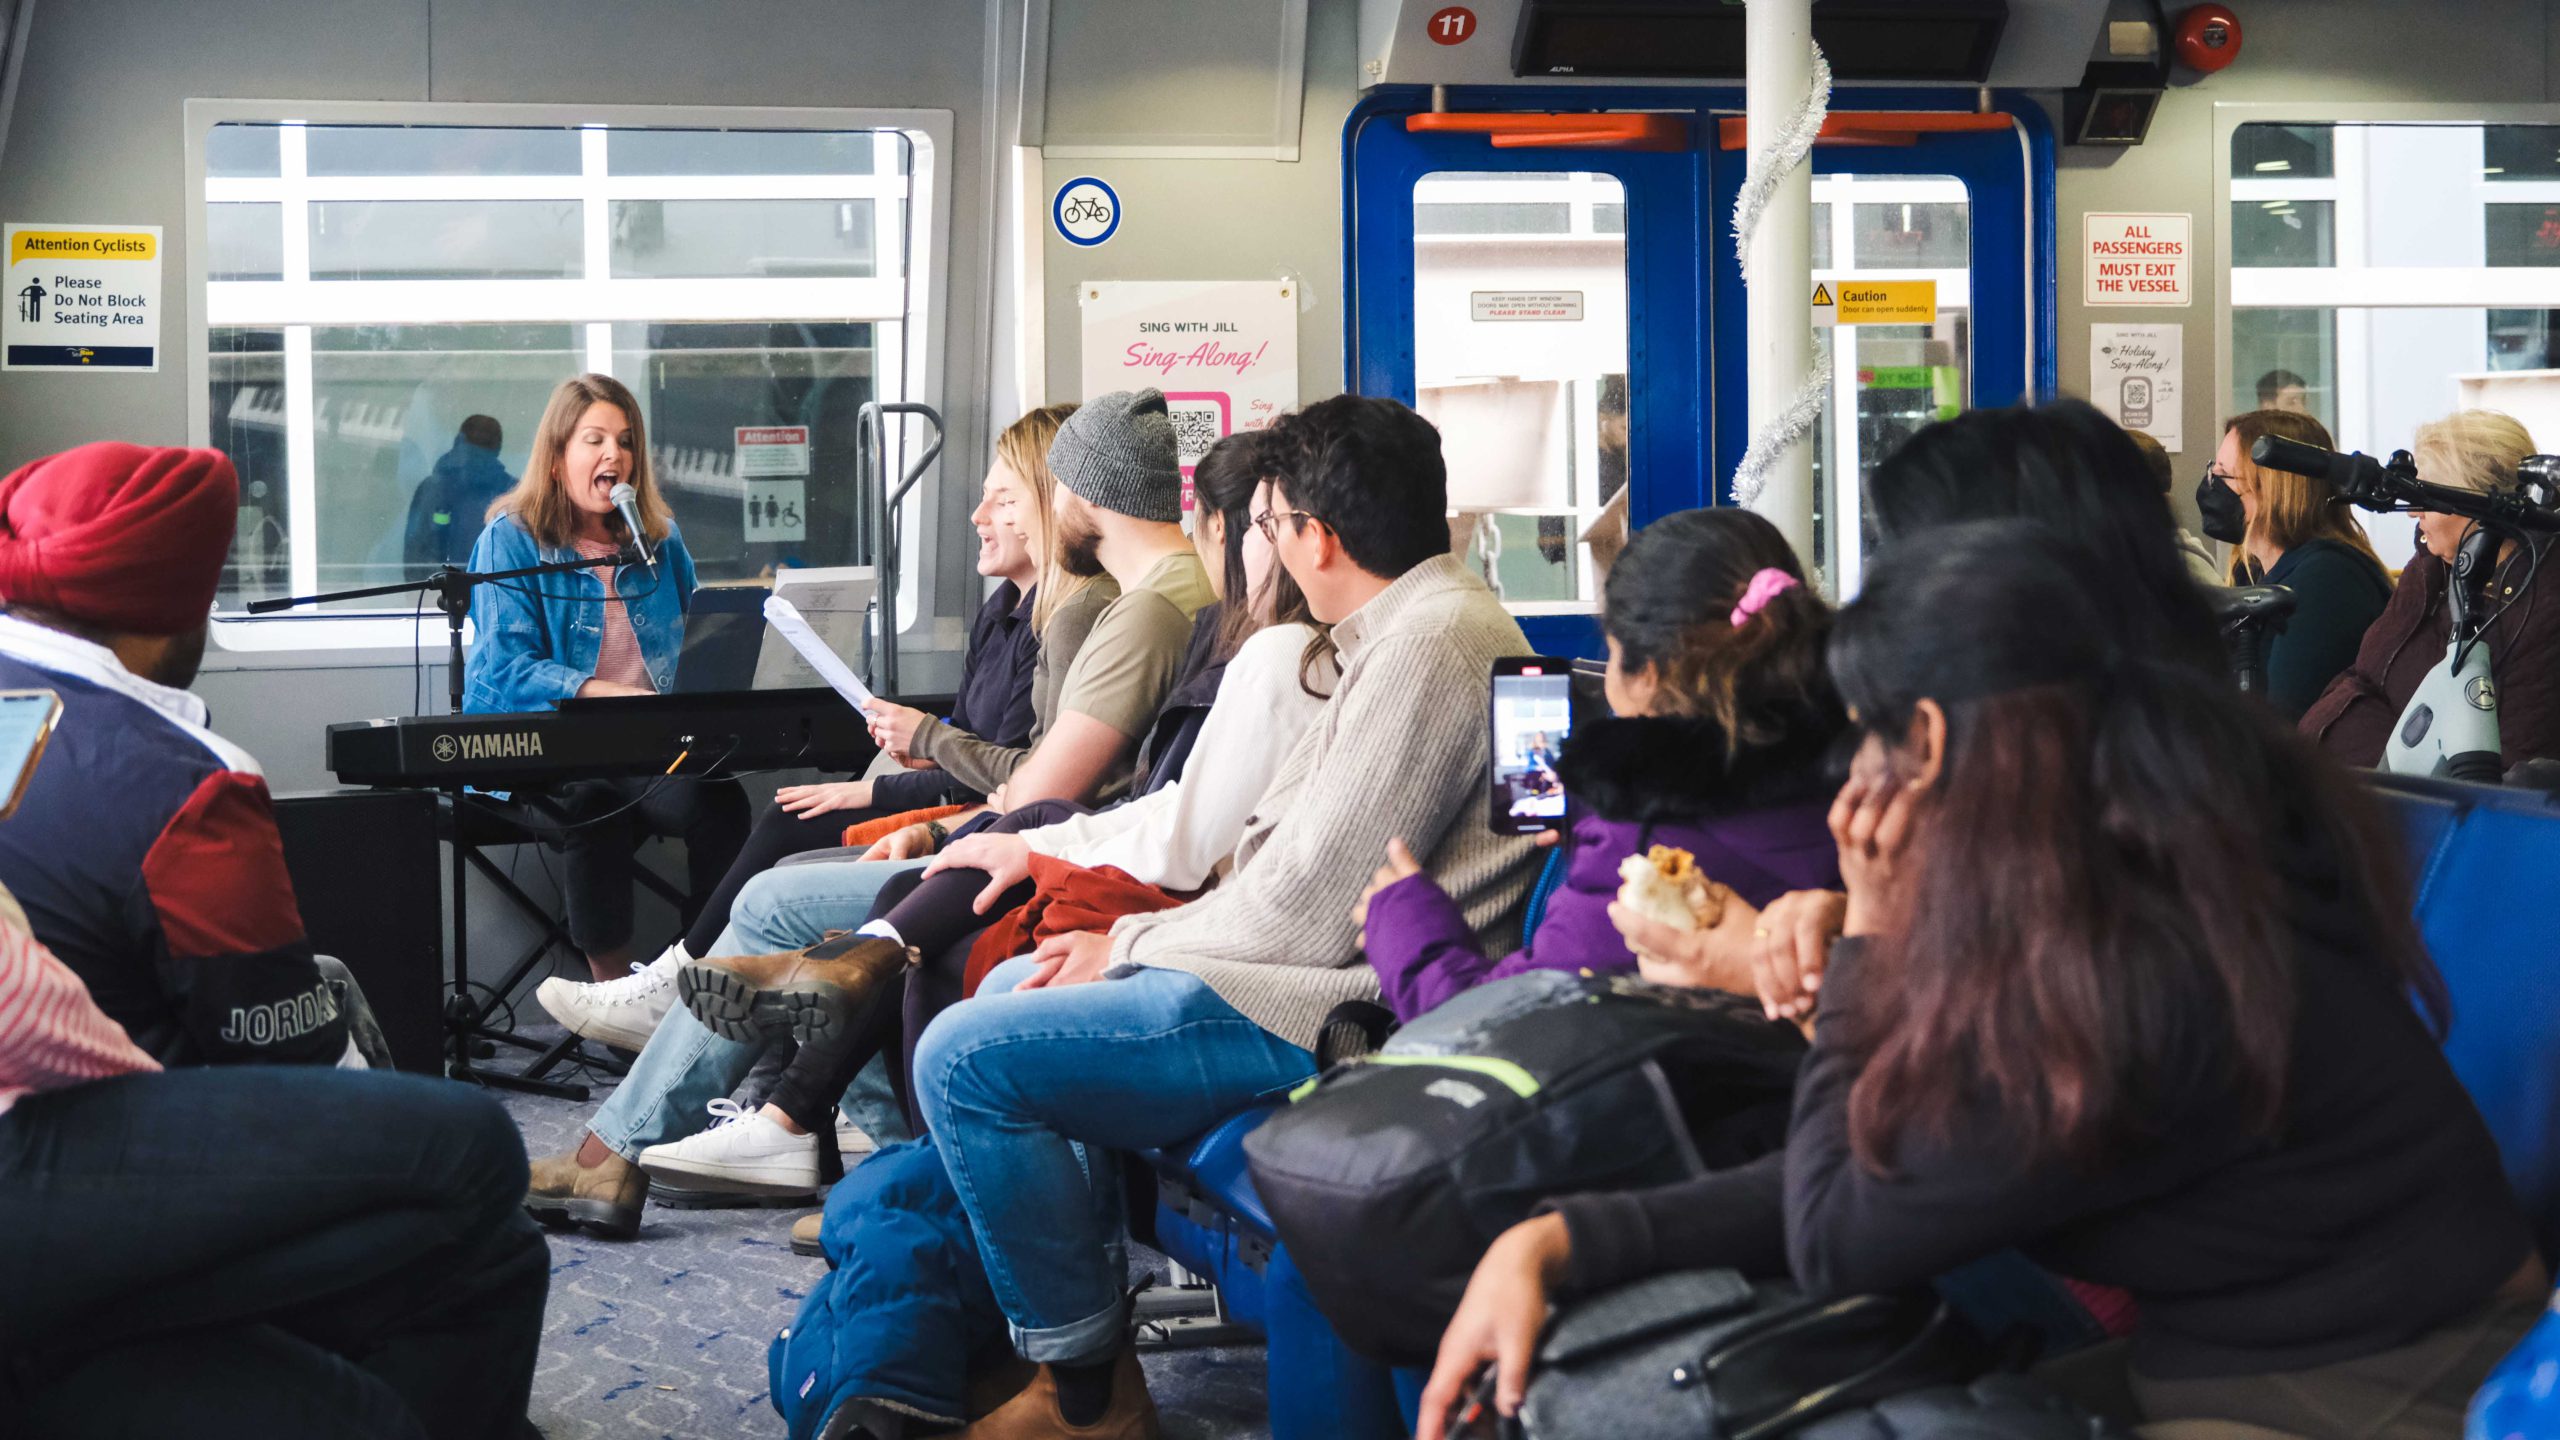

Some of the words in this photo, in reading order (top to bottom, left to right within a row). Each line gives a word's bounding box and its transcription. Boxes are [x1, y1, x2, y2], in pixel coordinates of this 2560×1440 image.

[1438, 15, 1465, 36] 11
[2125, 226, 2151, 238] ALL
[25, 238, 90, 250] Attention
[94, 238, 146, 254] Cyclists
[2093, 242, 2182, 254] PASSENGERS
[2100, 264, 2140, 276] MUST
[2145, 264, 2176, 276] EXIT
[55, 276, 102, 288] Please
[2096, 280, 2124, 292] THE
[2128, 280, 2179, 292] VESSEL
[54, 294, 74, 306] Do
[78, 294, 102, 306] Not
[108, 294, 146, 308] Block
[1843, 290, 1887, 302] Caution
[1896, 306, 1928, 314] suddenly
[54, 312, 108, 326] Seating
[112, 313, 144, 324] Area
[1140, 322, 1170, 332] SING
[1174, 322, 1208, 332] WITH
[1212, 322, 1238, 332] JILL
[1123, 340, 1269, 376] Sing-Along!
[2120, 345, 2156, 360] Holiday
[2110, 358, 2170, 372] Sing-Along!
[1250, 399, 1274, 412] Sing
[1244, 417, 1264, 429] with
[744, 432, 800, 442] Attention
[458, 732, 543, 759] YAMAHA
